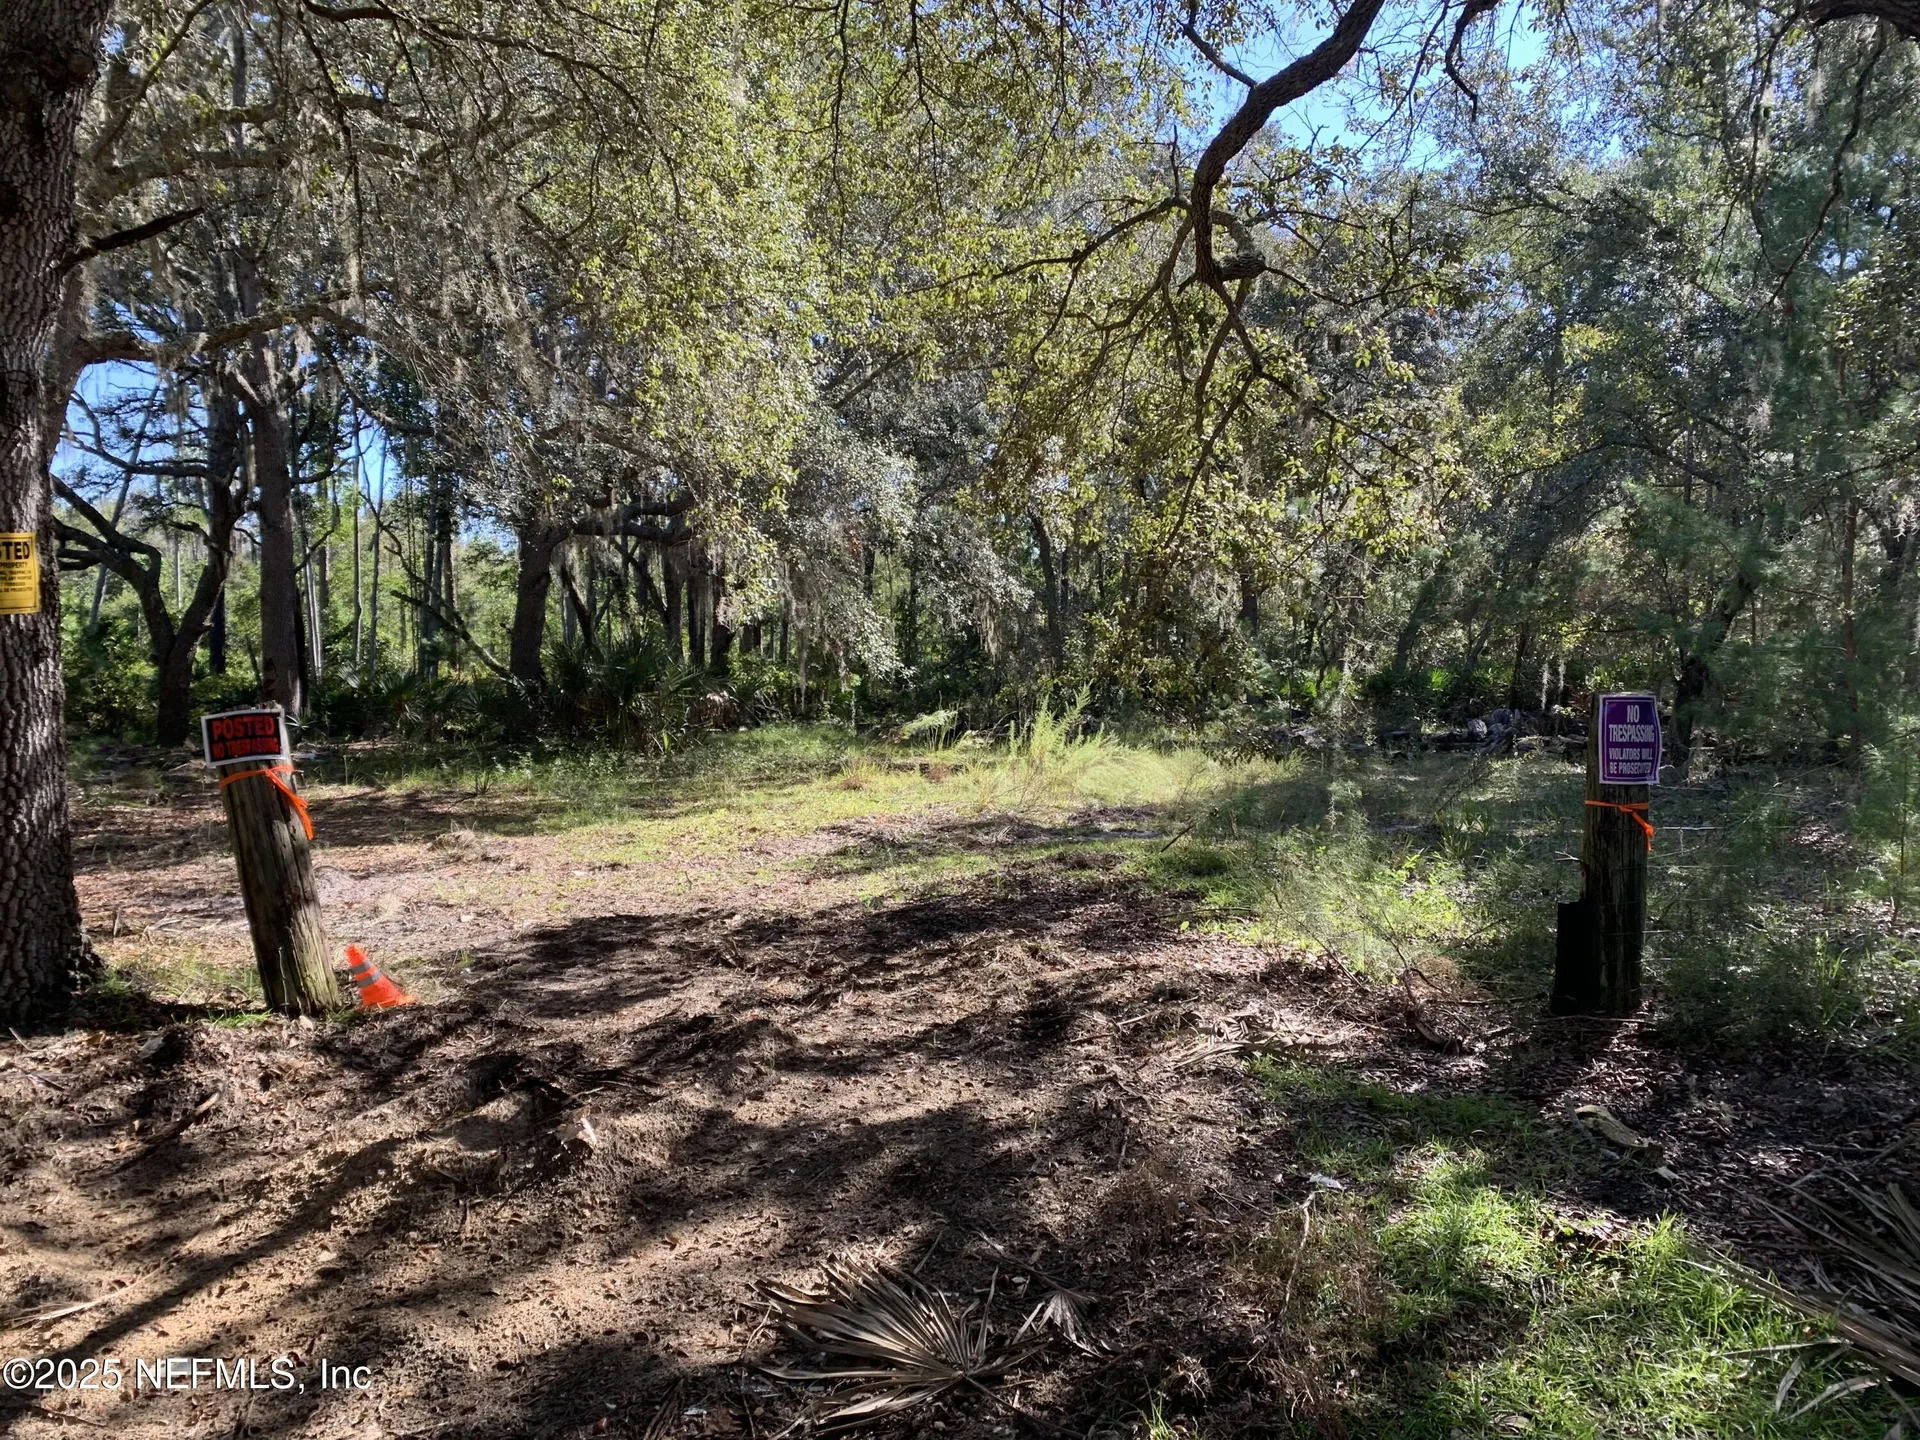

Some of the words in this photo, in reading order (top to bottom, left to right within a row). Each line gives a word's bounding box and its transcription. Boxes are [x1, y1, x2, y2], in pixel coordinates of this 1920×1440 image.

[0, 541, 30, 560] TED
[1627, 704, 1640, 723] NO
[211, 715, 275, 741] POSTED
[1608, 724, 1655, 743] TRESPASSING
[1608, 747, 1640, 760] VIOLATORS
[1641, 747, 1653, 760] WILL
[1609, 761, 1617, 774] BE
